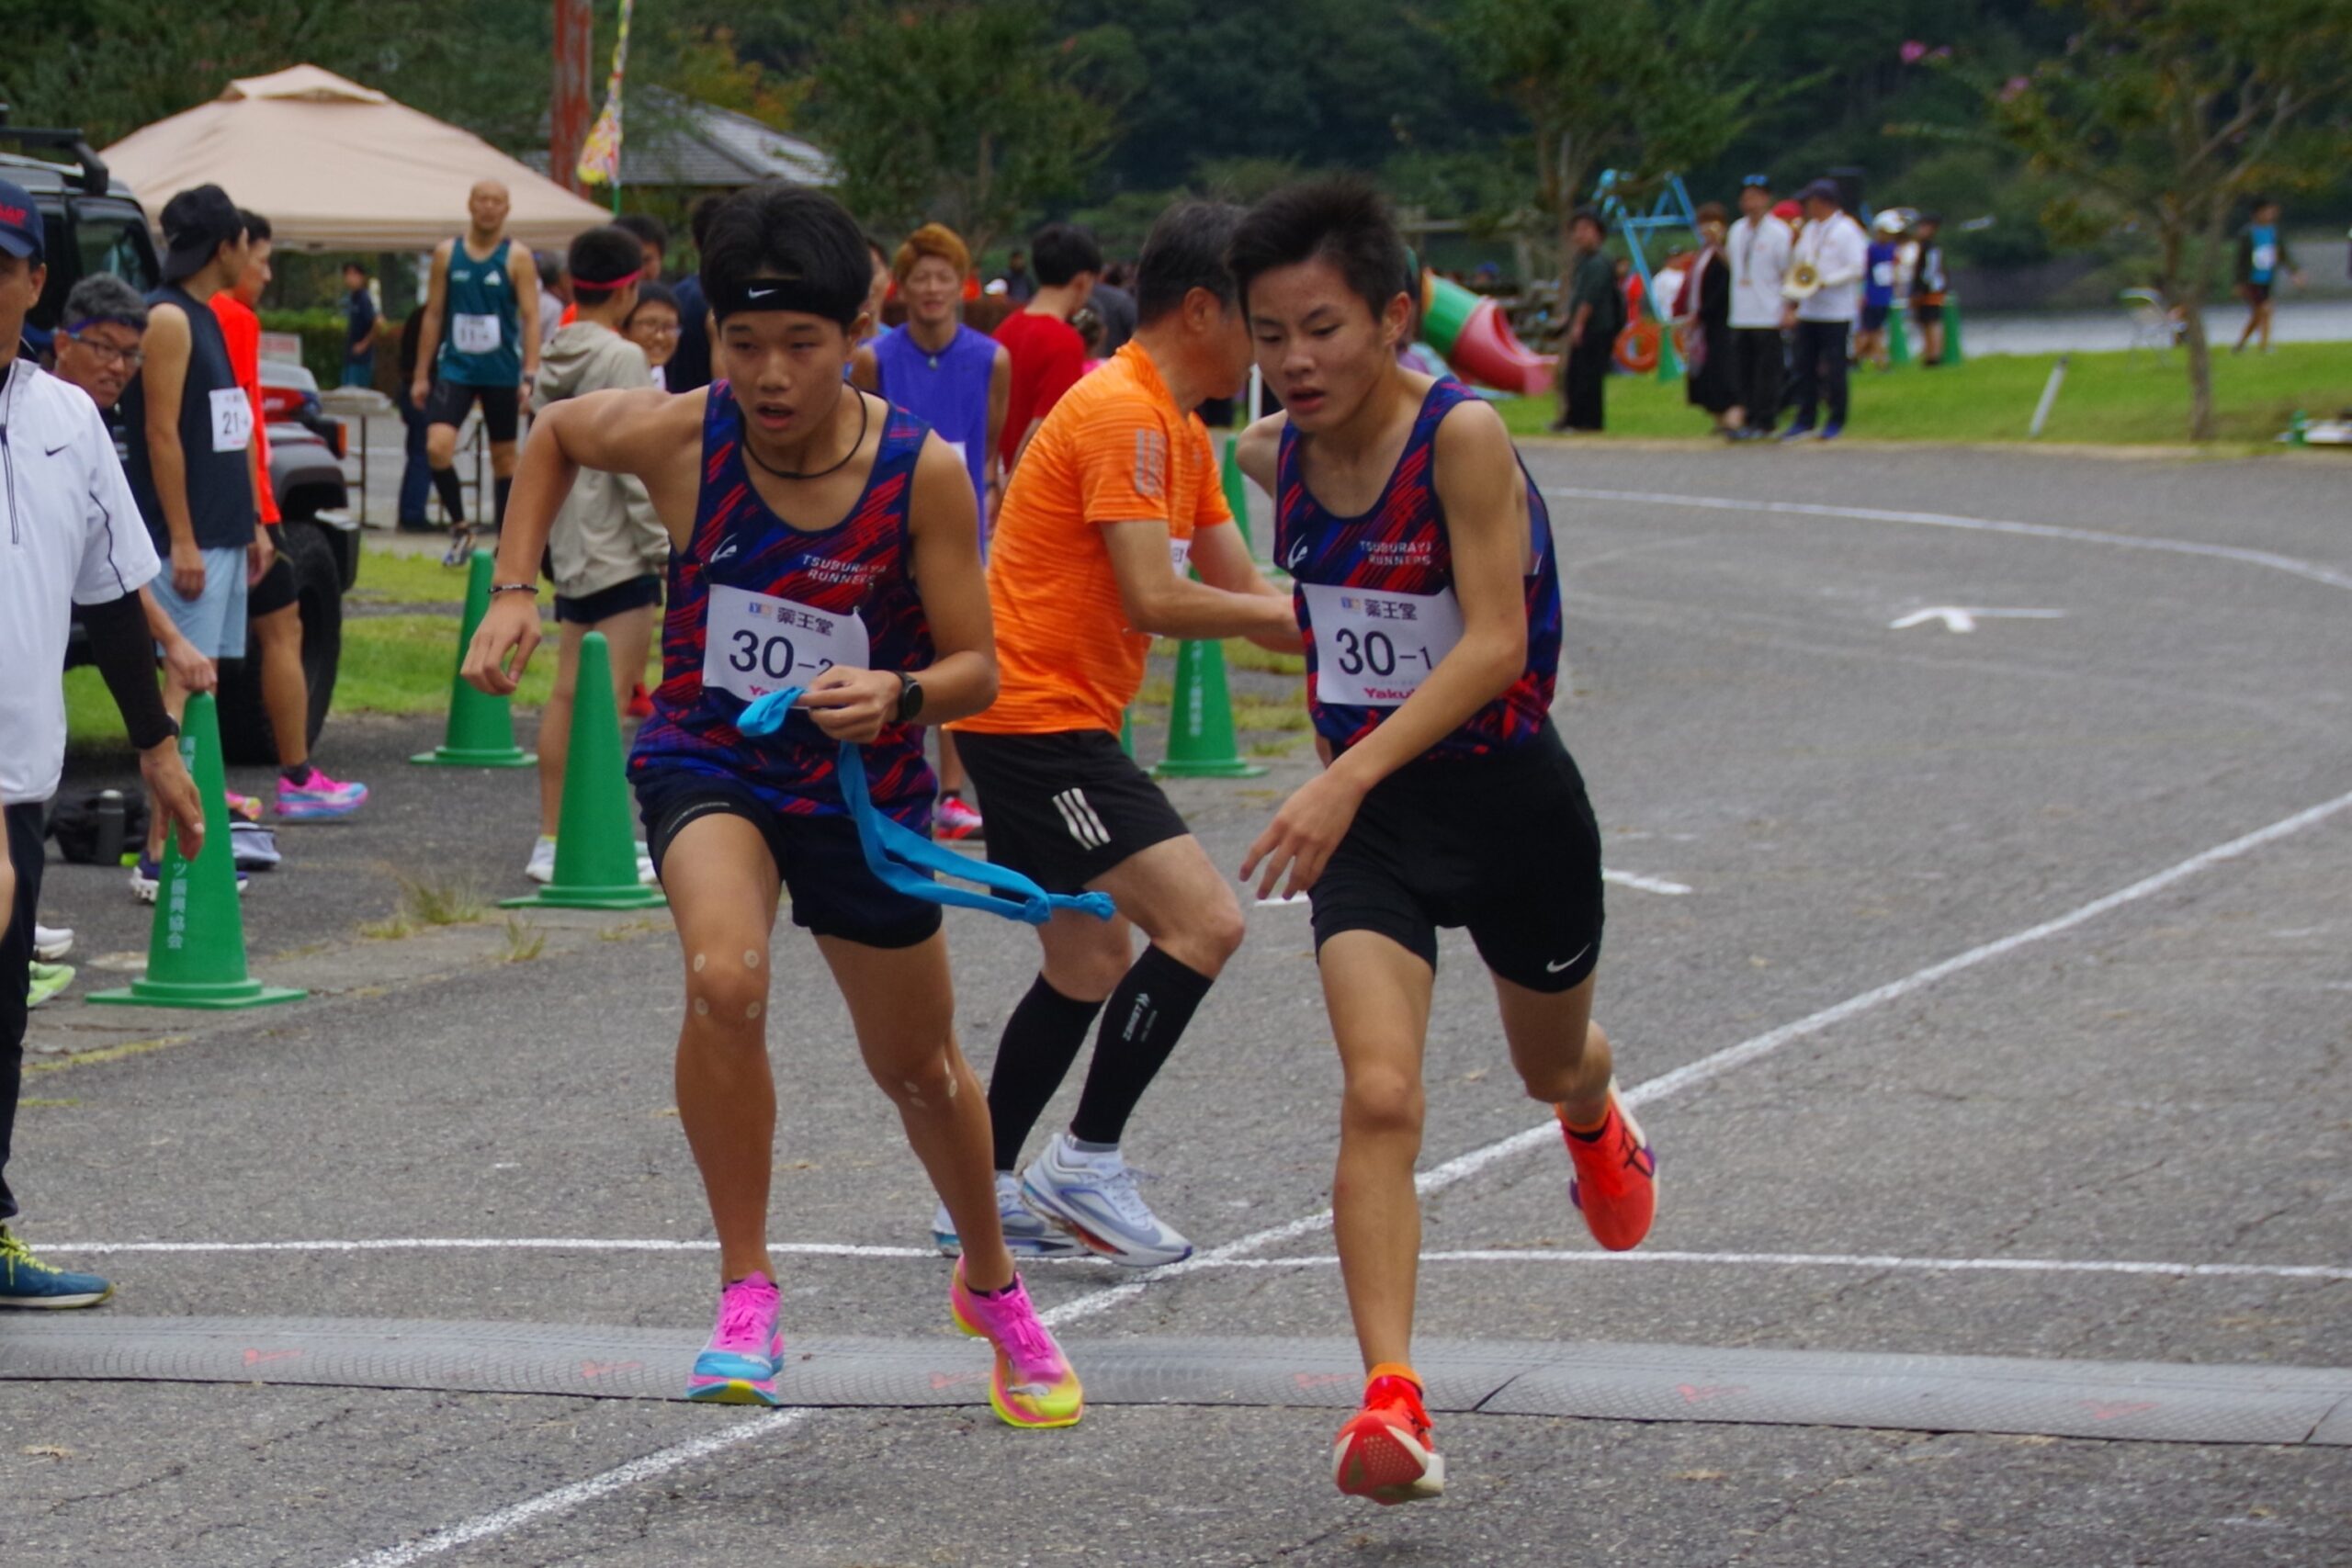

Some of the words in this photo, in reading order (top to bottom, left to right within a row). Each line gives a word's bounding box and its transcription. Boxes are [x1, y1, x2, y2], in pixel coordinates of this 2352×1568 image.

[777, 606, 834, 636] 薬王堂
[1336, 627, 1432, 676] 30-1
